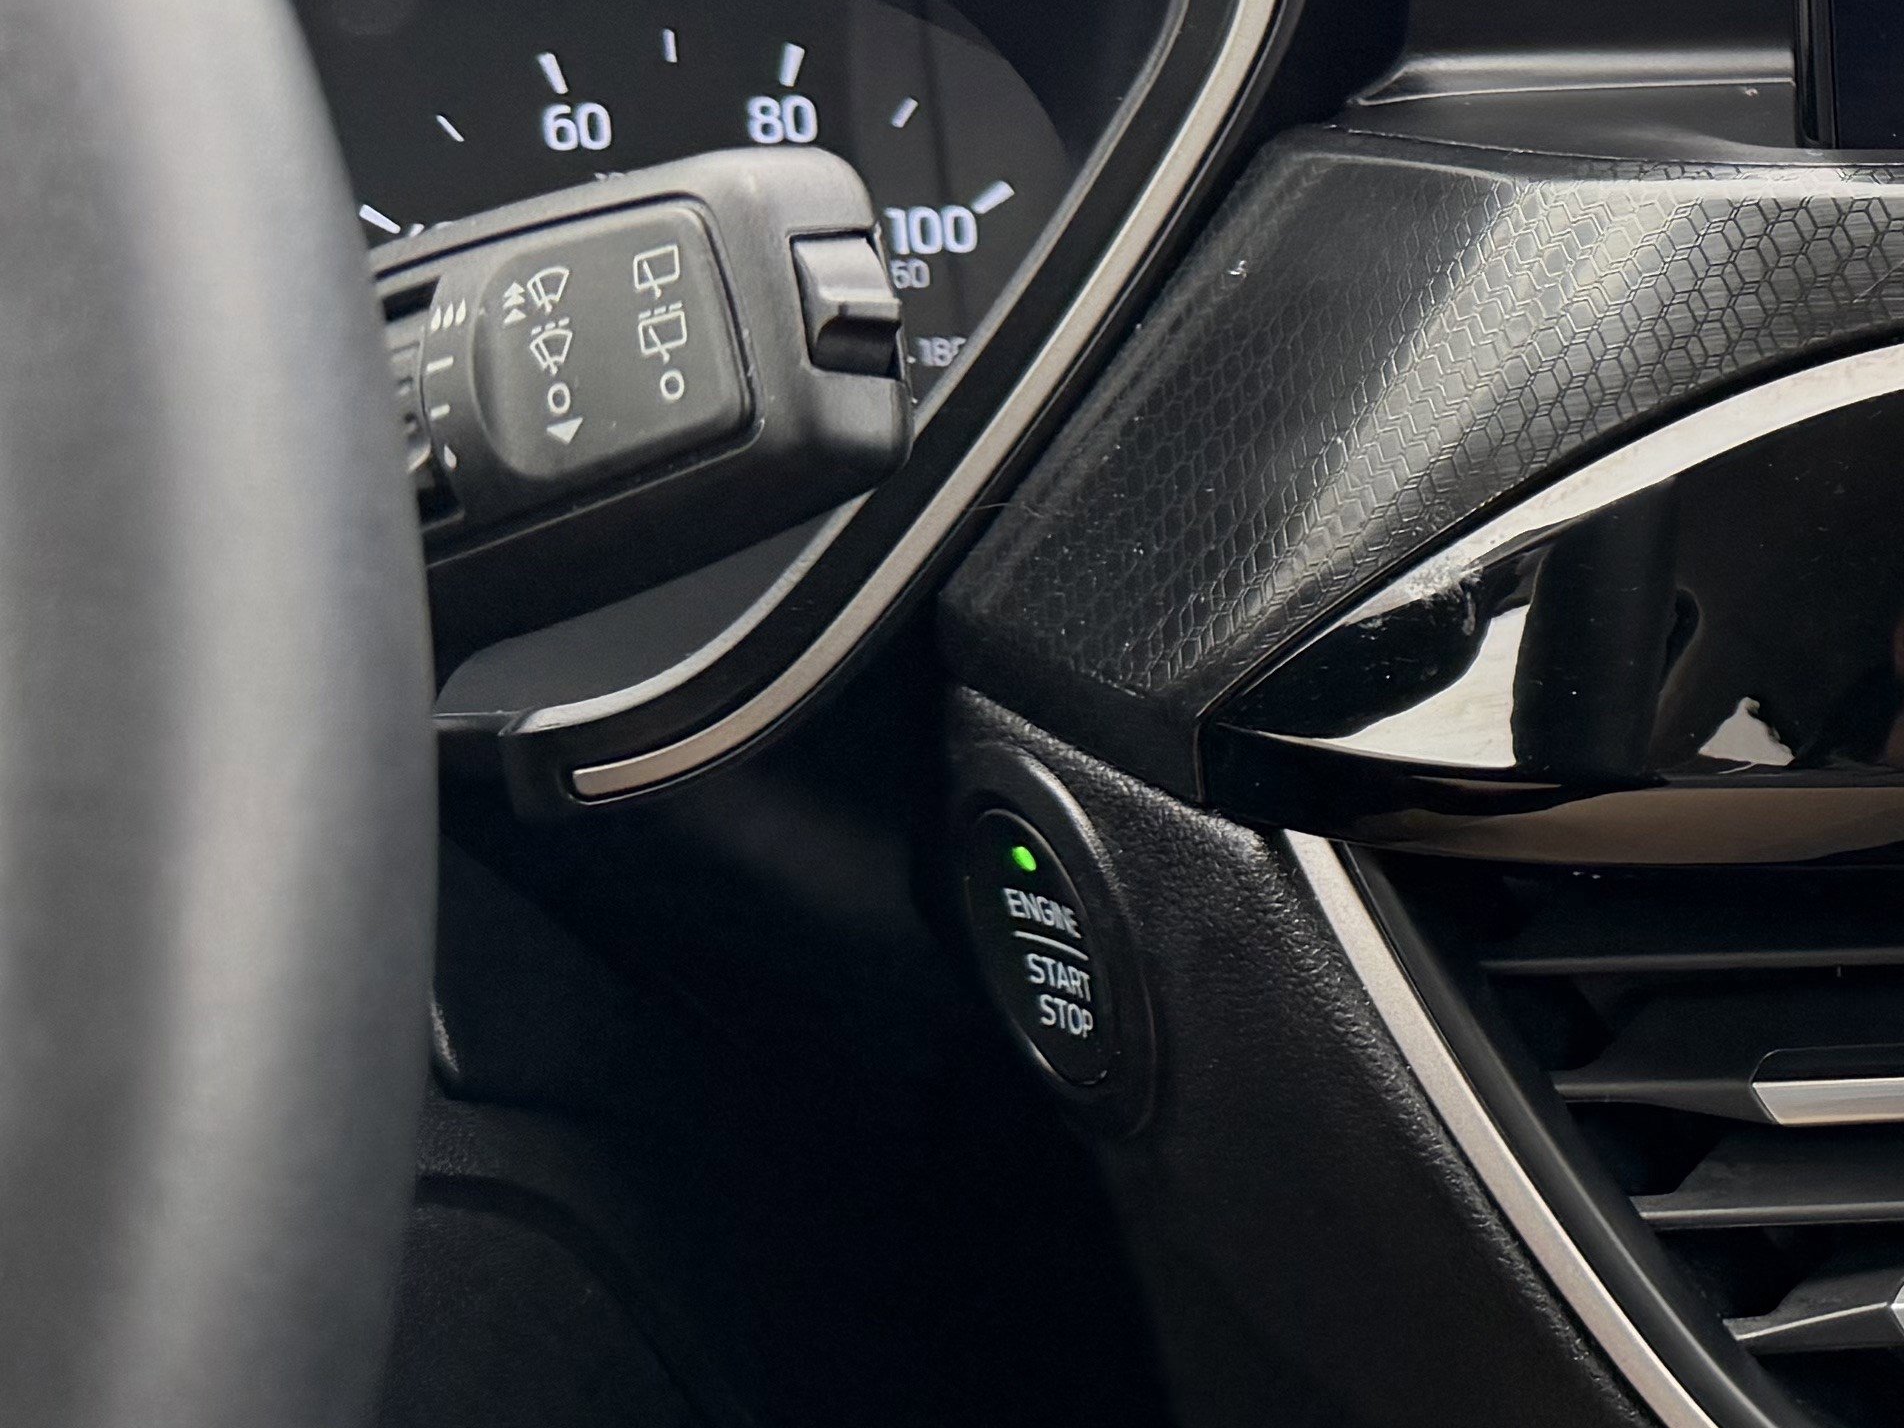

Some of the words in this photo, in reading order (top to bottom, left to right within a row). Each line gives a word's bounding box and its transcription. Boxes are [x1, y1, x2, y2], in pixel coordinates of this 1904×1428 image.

[541, 102, 613, 152] 60
[746, 95, 819, 145] 80
[884, 204, 978, 255] 100
[1003, 887, 1081, 939] ENGINE
[1026, 952, 1091, 1002] START
[1039, 993, 1093, 1038] STOP
